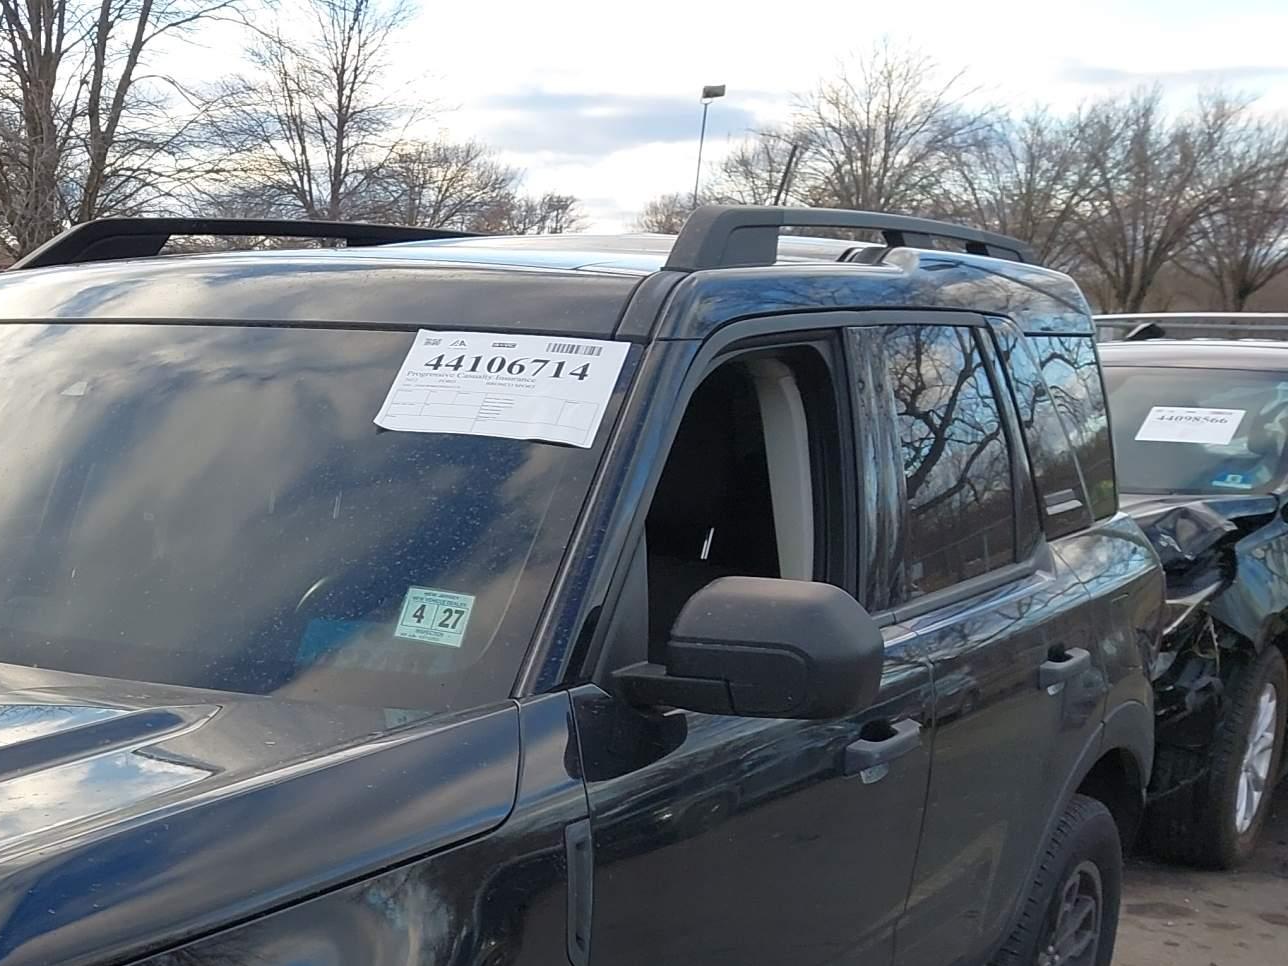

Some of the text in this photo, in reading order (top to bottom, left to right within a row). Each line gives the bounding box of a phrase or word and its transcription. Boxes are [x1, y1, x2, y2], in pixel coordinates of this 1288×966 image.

[424, 353, 592, 381] 44106714
[412, 604, 465, 630] 4 27
